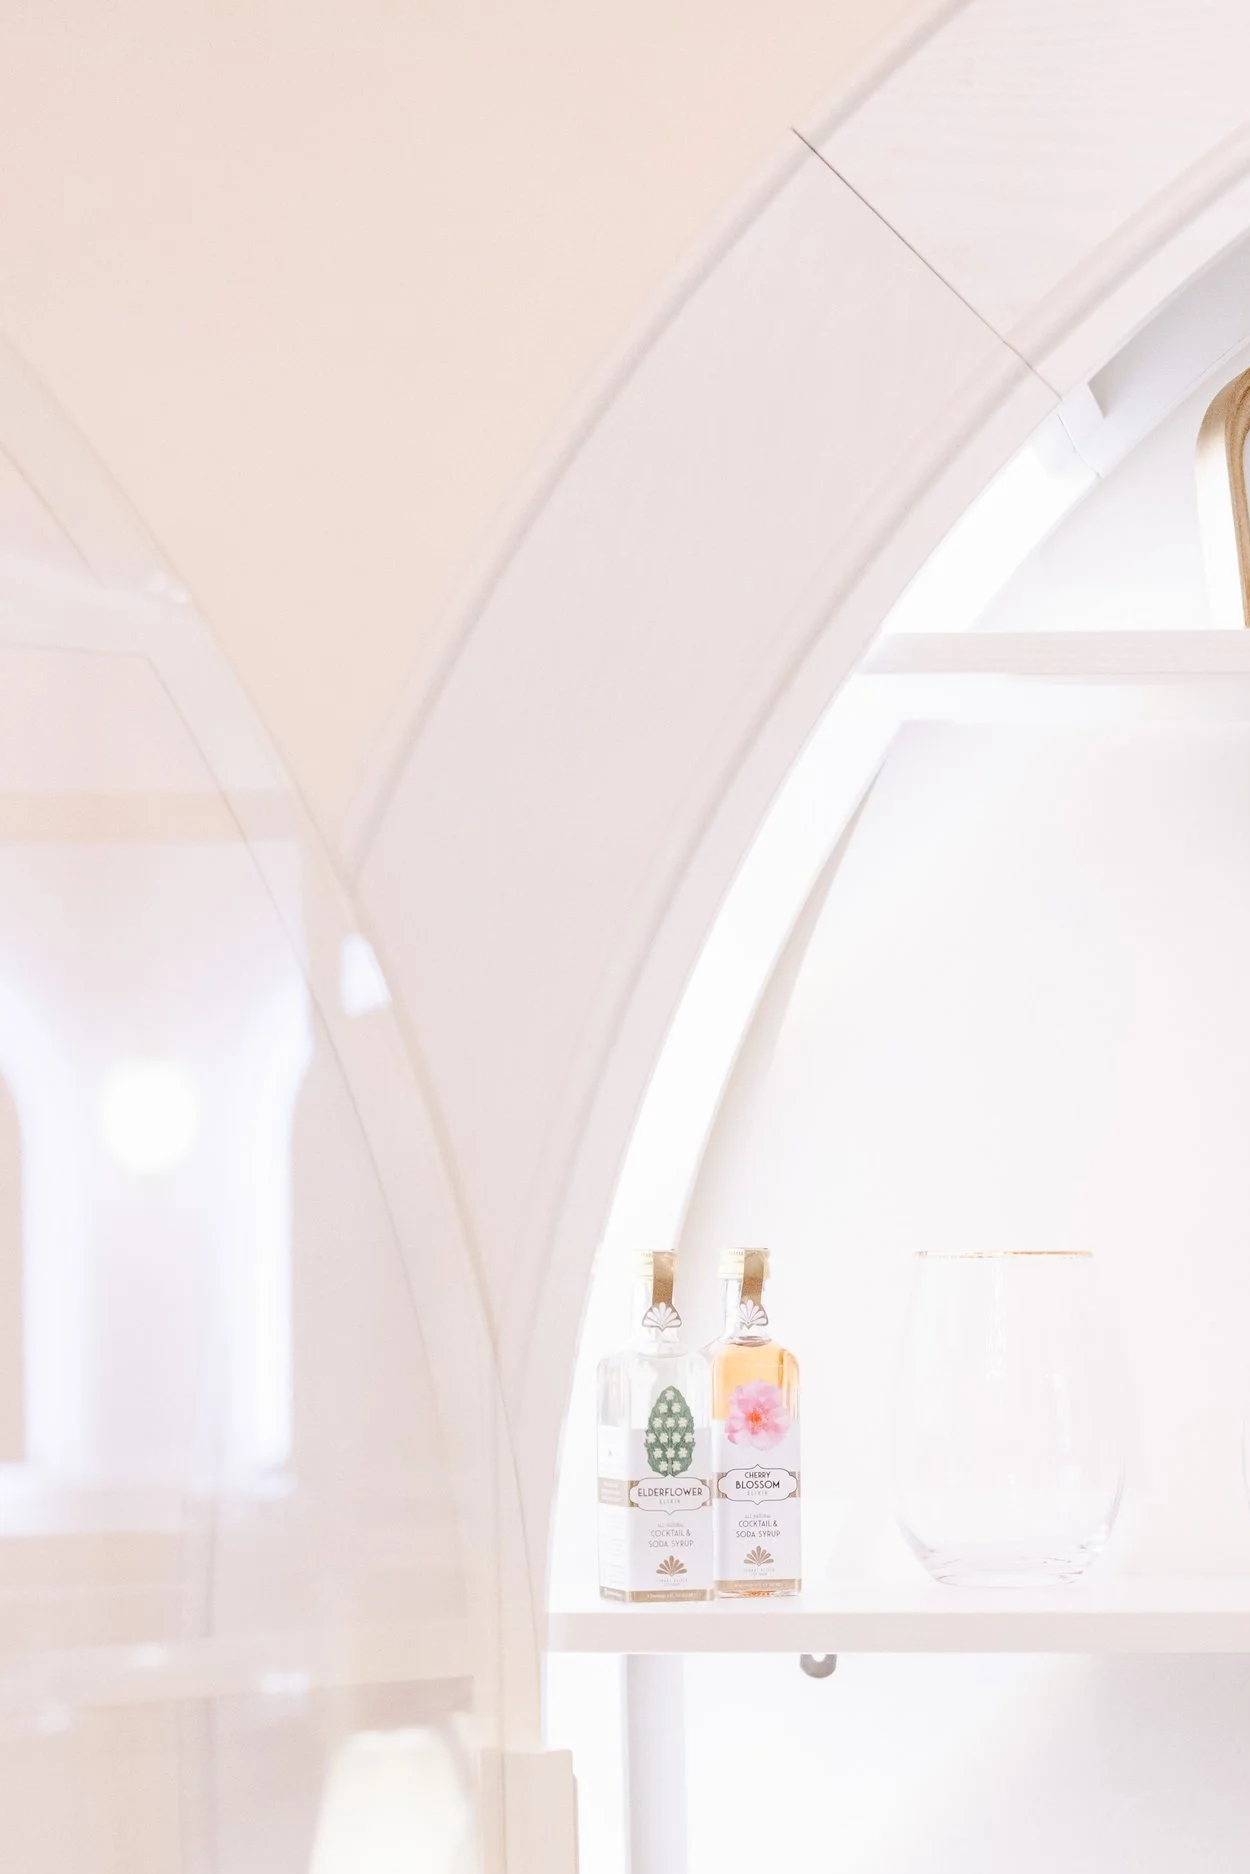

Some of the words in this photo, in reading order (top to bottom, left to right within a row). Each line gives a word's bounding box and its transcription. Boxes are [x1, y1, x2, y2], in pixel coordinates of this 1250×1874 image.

[744, 1471, 771, 1479] CHERRY
[735, 1480, 780, 1490] BLOSSOM
[637, 1487, 703, 1497] ELDERFLOWER
[772, 1520, 778, 1528] &
[650, 1529, 684, 1537] COCKTAIL
[685, 1529, 691, 1537] &
[735, 1530, 756, 1538] SODA
[758, 1530, 781, 1538] SYRUP
[648, 1540, 669, 1548] SODA
[671, 1540, 693, 1548] SYRUP
